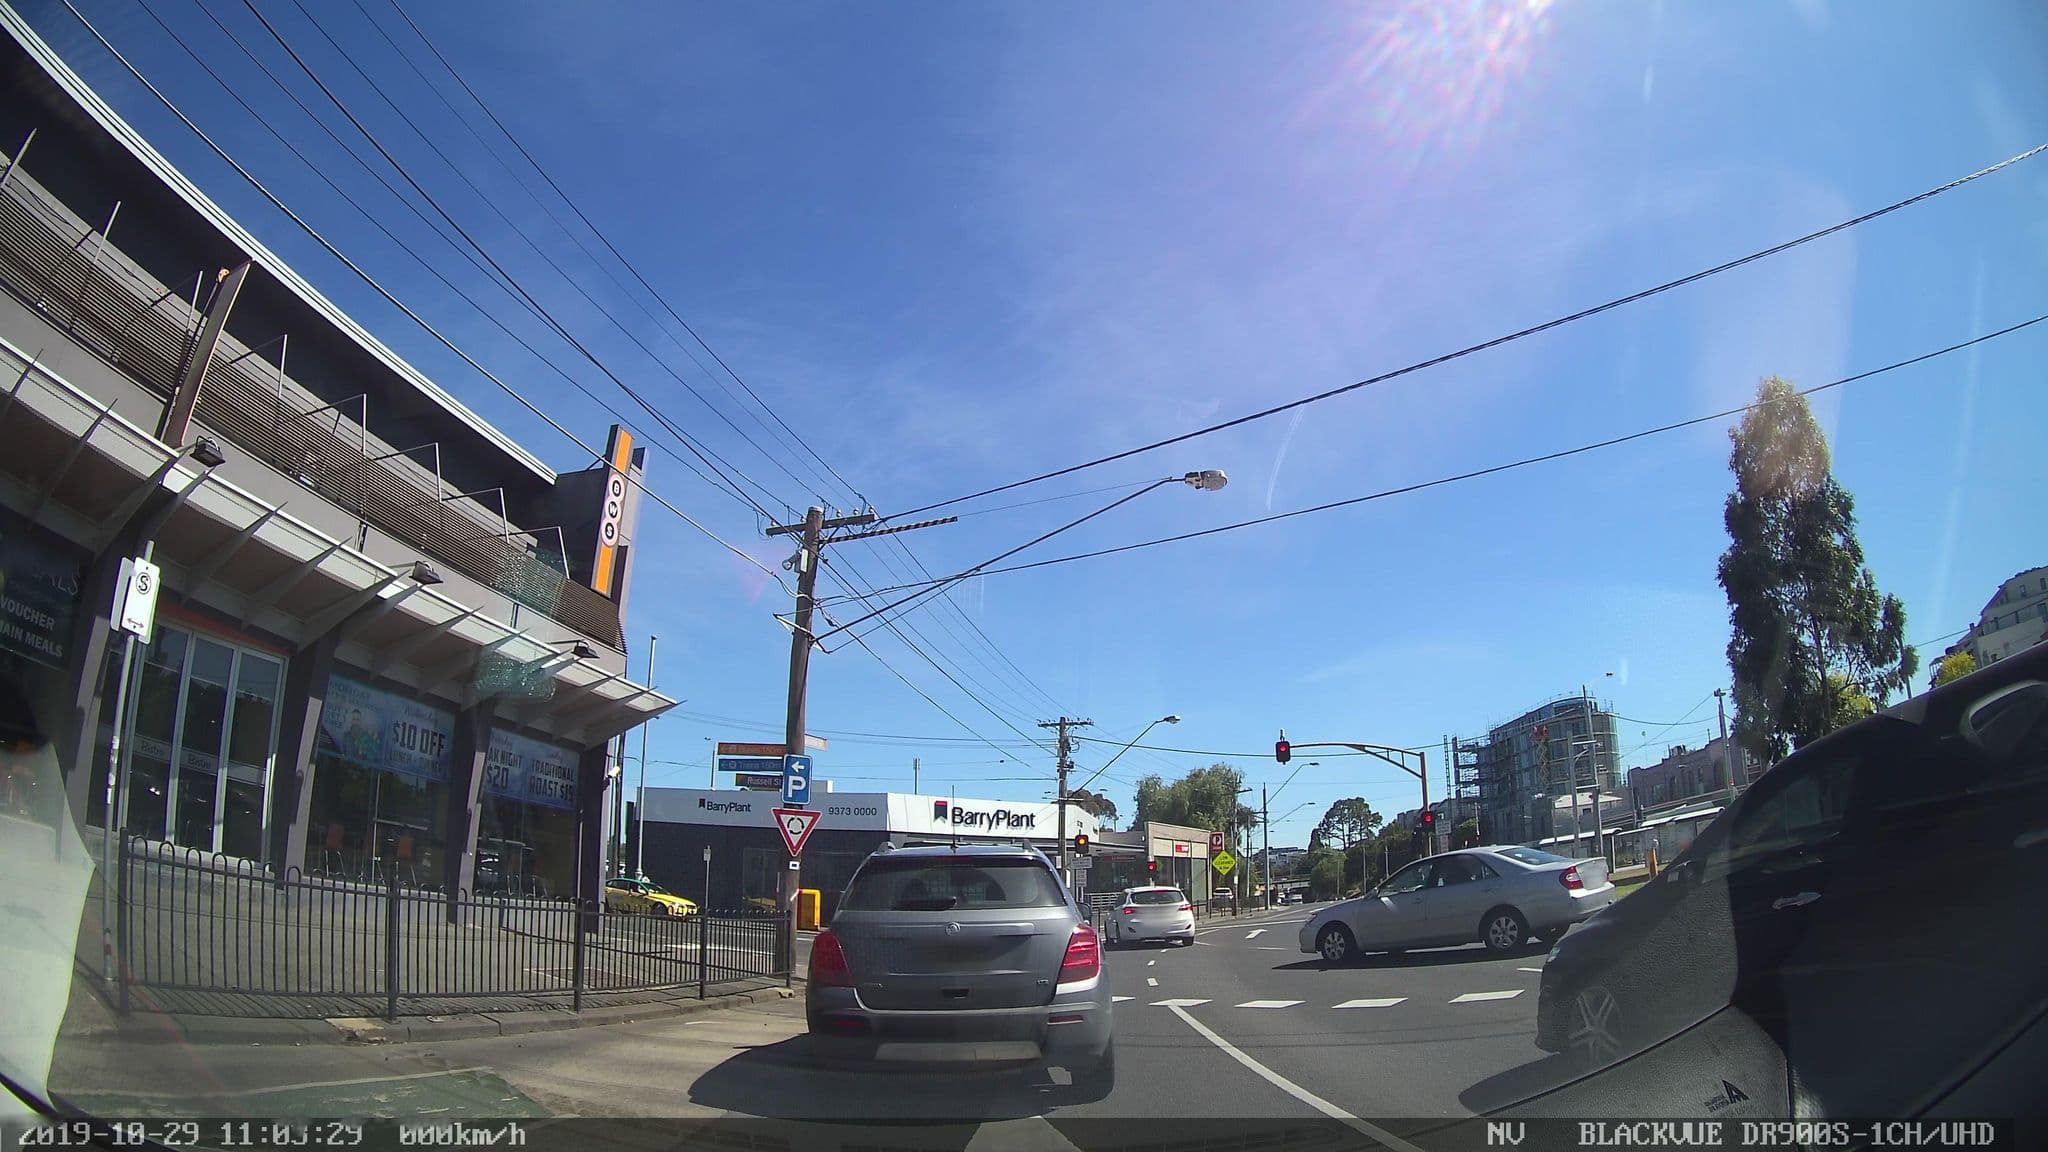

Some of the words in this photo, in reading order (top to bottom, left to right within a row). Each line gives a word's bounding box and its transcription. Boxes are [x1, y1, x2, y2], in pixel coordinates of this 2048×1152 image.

[604, 479, 622, 540] BWS
[0, 594, 56, 631] VOUCHER
[25, 631, 63, 657] MEALS
[393, 720, 417, 750] $10
[420, 728, 446, 757] OFF
[500, 750, 522, 768] NIGHT
[530, 759, 576, 782] TRADITIONAL
[487, 764, 509, 789] $20
[529, 775, 559, 798] ROAST
[747, 776, 772, 786] Russell
[787, 775, 807, 798] P
[706, 801, 752, 814] BarryPlant
[828, 806, 851, 817] 9373
[853, 807, 878, 818] 0000
[952, 806, 1036, 832] BarryPlant
